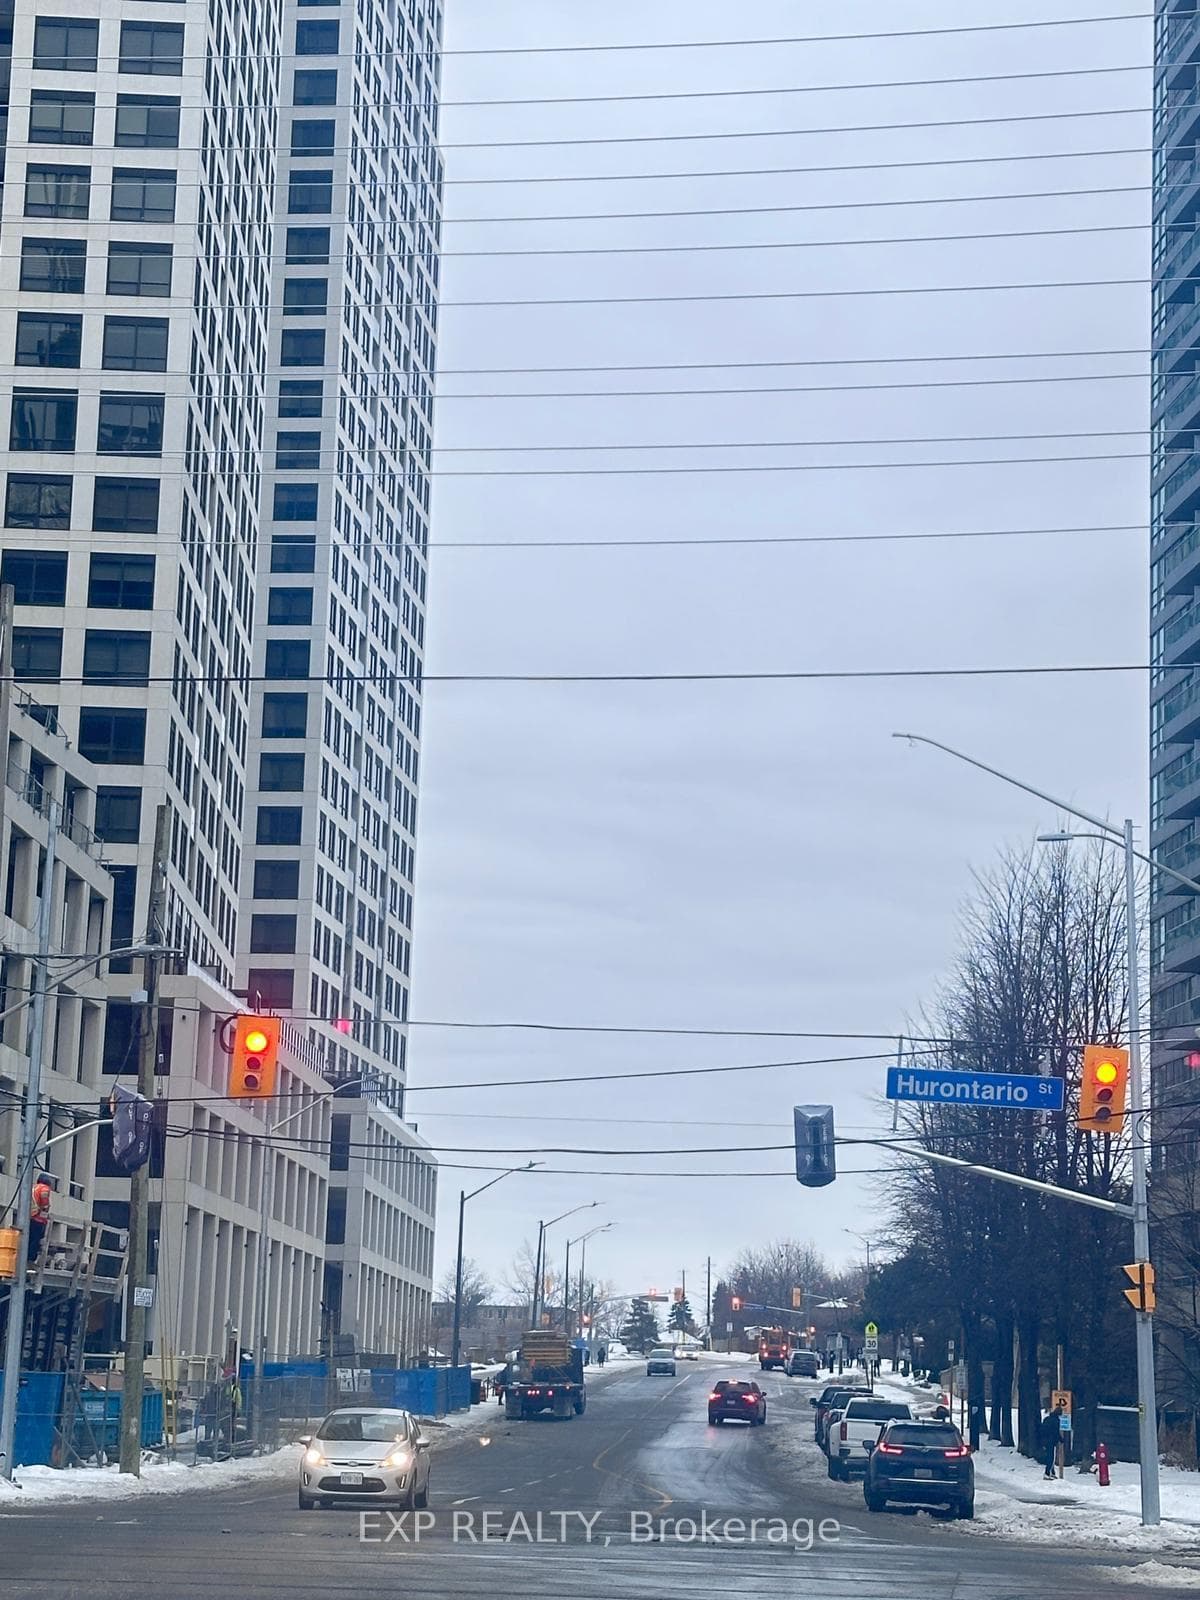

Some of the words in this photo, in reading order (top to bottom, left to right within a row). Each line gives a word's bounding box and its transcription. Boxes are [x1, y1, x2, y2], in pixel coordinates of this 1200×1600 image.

[897, 1074, 1028, 1101] Hurontario
[1038, 1083, 1052, 1095] St
[867, 1340, 877, 1348] 30
